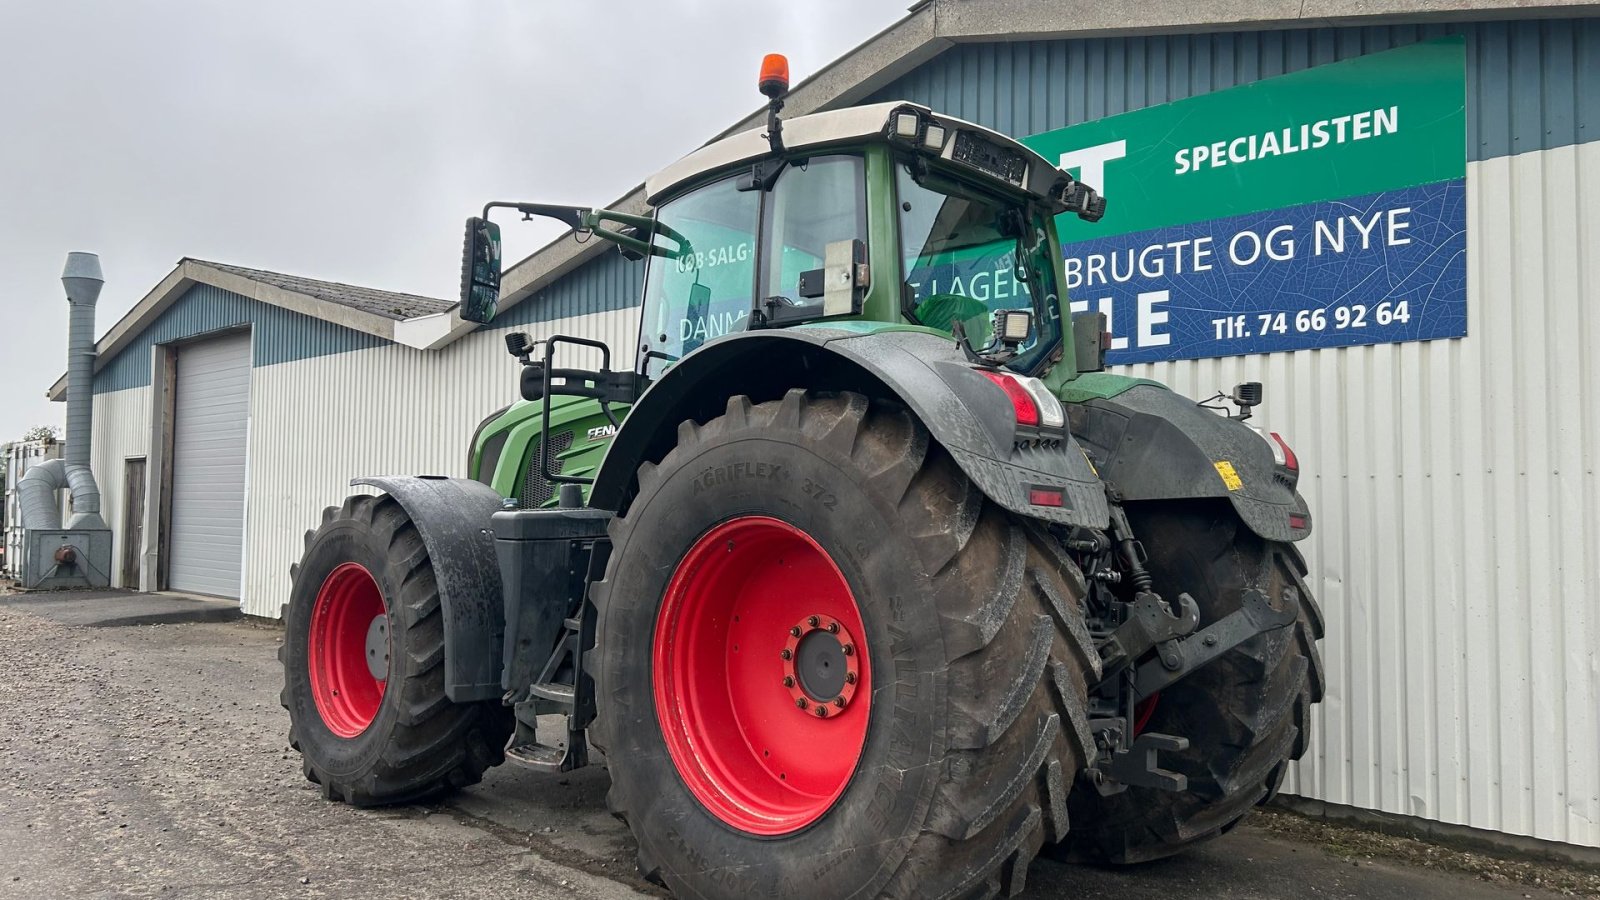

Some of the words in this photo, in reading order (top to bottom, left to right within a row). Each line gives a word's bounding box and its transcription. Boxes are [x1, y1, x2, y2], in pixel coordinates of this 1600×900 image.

[1175, 106, 1399, 175] SPECIALISTEN
[1064, 236, 1213, 289] BRUGTE
[1229, 215, 1295, 266] OG
[1315, 207, 1411, 256] NYE
[1212, 315, 1250, 340] Tlf.
[1258, 312, 1288, 336] 74
[1295, 308, 1327, 333] 66
[1334, 305, 1367, 330] 92
[1376, 300, 1411, 326] 64
[801, 477, 839, 513] 372
